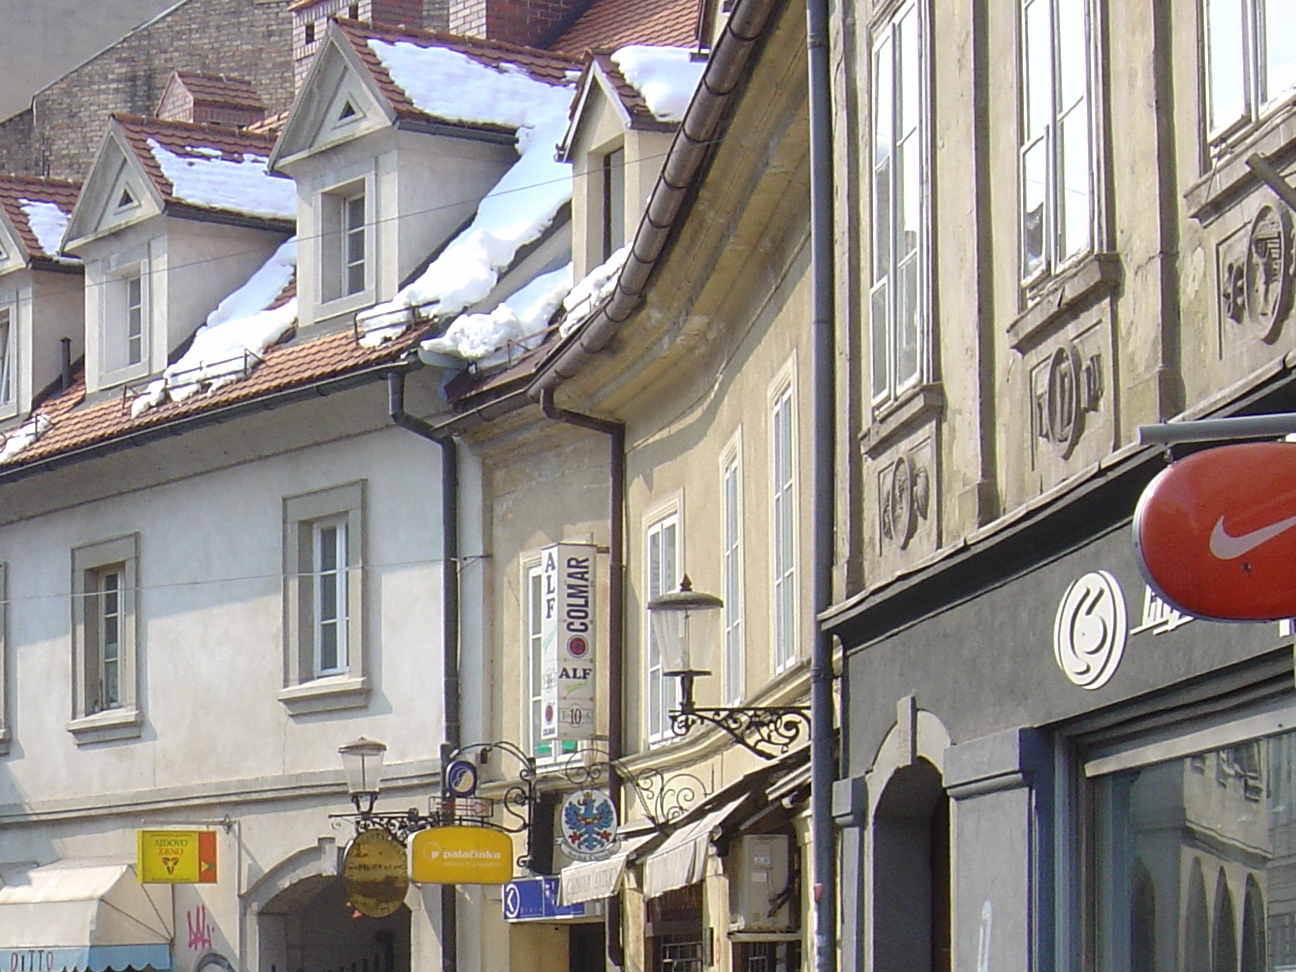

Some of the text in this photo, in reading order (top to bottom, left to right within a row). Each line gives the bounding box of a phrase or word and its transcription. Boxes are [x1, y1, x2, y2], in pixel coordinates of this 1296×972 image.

[566, 557, 589, 633] COLMAR
[558, 667, 592, 680] ALF
[443, 849, 501, 860] palačinka
[10, 950, 54, 972] DITTO
